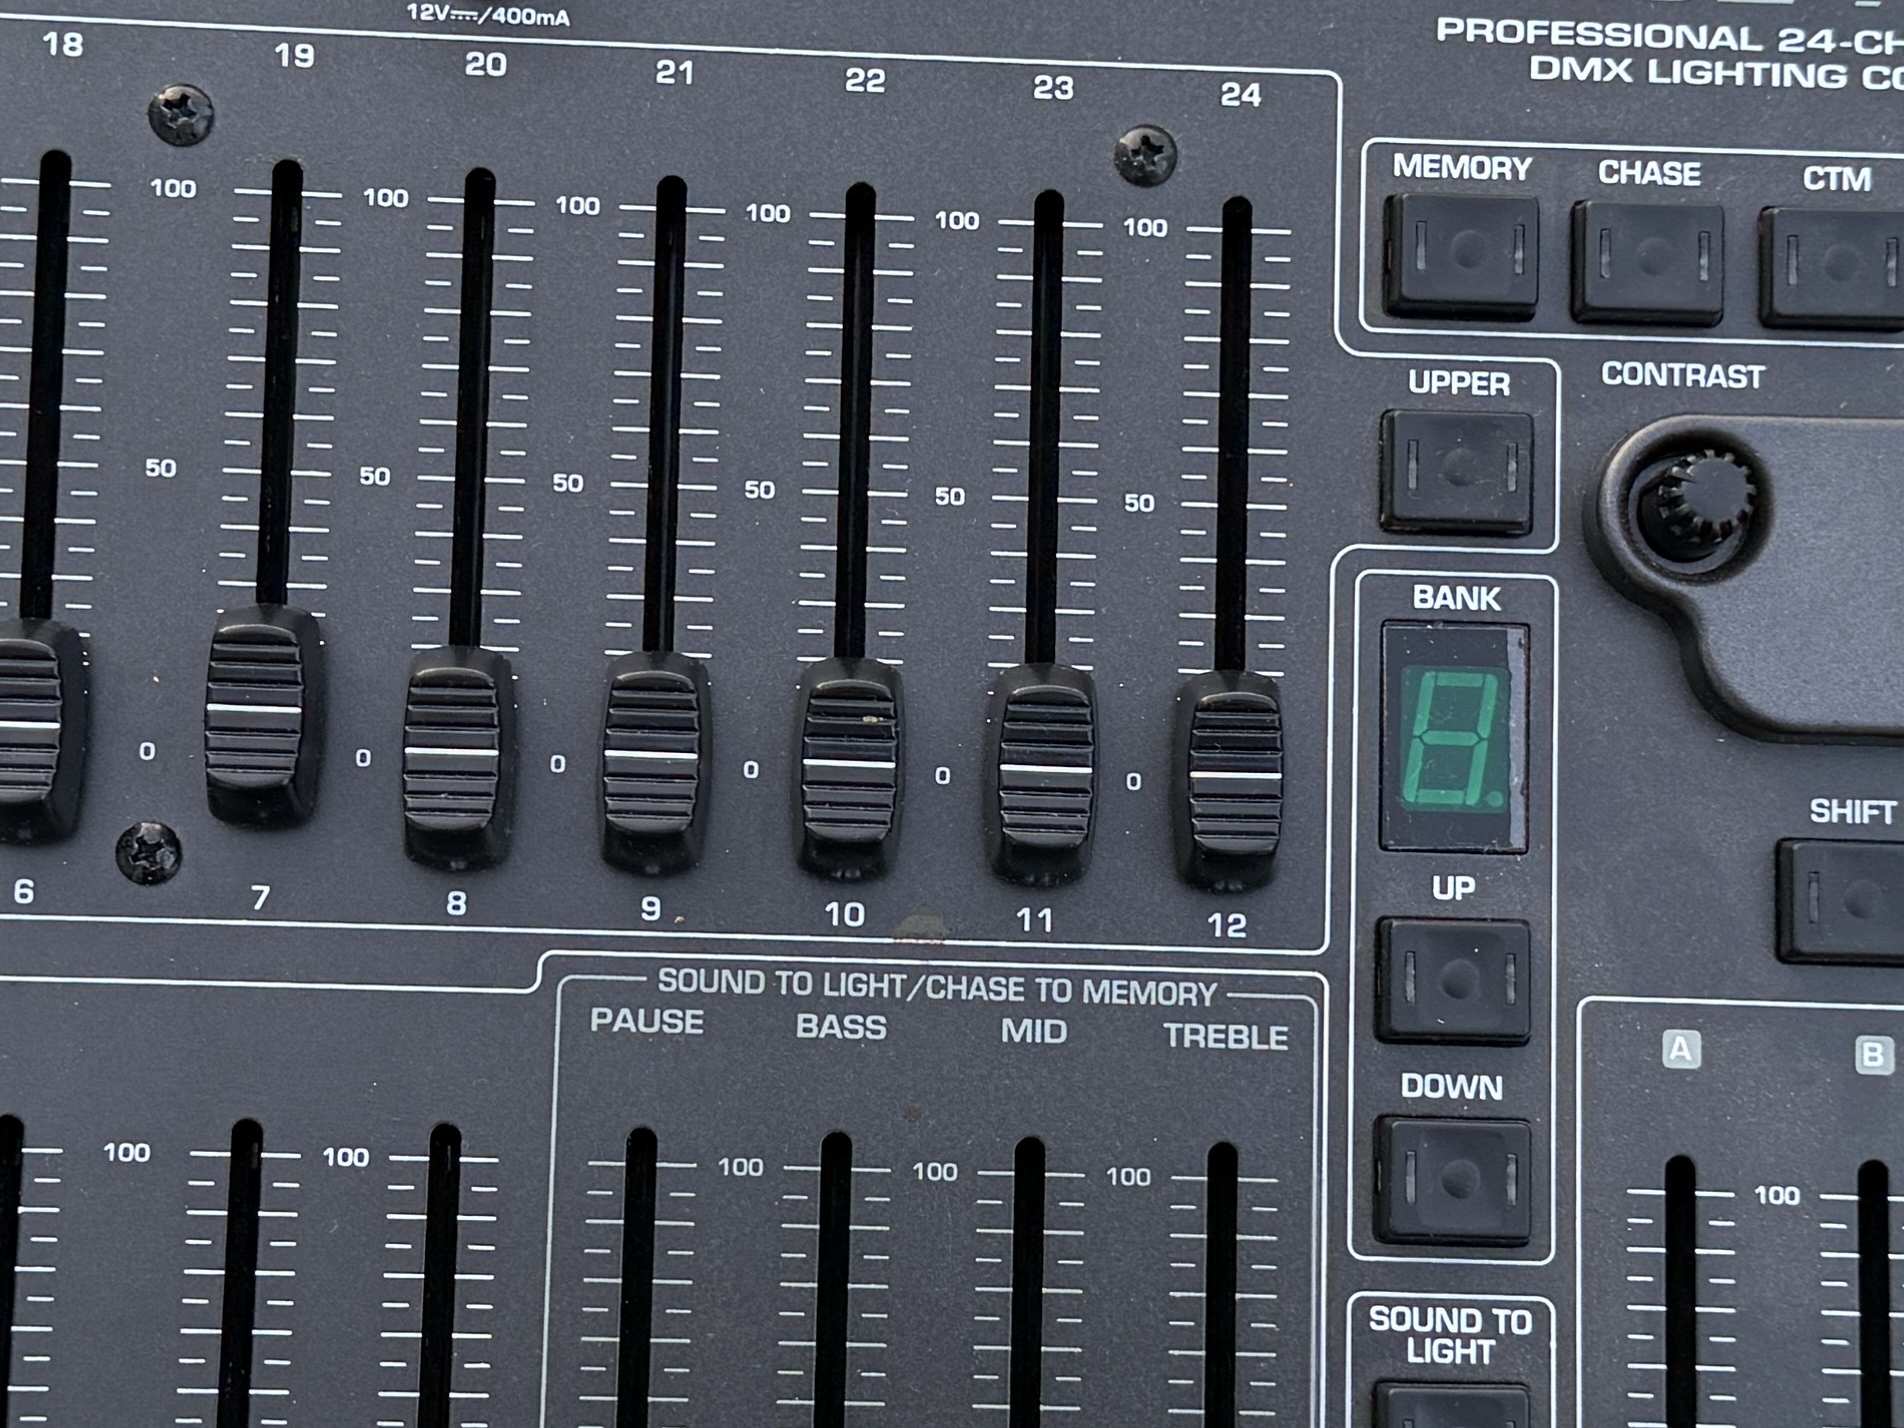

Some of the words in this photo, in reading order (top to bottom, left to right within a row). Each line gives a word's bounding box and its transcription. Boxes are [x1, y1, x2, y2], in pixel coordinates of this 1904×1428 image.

[43, 31, 83, 57] 18
[1438, 17, 1764, 52] PROFESSIONAL
[275, 42, 315, 68] 19
[465, 51, 507, 77] 20
[656, 59, 693, 85] 21
[845, 67, 886, 93] 22
[1531, 55, 1634, 83] DMX
[1648, 58, 1847, 91] LIGHTING
[1033, 74, 1074, 100] 23
[1221, 81, 1262, 107] 24
[1394, 152, 1533, 181] MEMORY
[1599, 159, 1701, 186] CHASE
[1804, 165, 1872, 192] CTM
[1409, 369, 1511, 396] UPPER
[1602, 360, 1767, 389] CONTRAST
[1413, 584, 1501, 611] BANK
[1810, 798, 1898, 825] SHIFT
[14, 878, 34, 904] 6
[251, 884, 270, 910] 7
[1433, 875, 1476, 901] UP
[446, 891, 466, 916] 8
[641, 896, 661, 921] 9
[825, 901, 865, 927] 10
[1016, 907, 1052, 933] 11
[1208, 912, 1247, 938] 12
[658, 966, 763, 996] SOUND
[774, 969, 815, 996] TO
[823, 972, 1025, 1002] LIGHT/CHASE
[1034, 976, 1073, 1006] TO
[1082, 979, 1218, 1007] MEMORY
[591, 1007, 704, 1034] PAUSE
[796, 1013, 887, 1040] BASS
[1002, 1018, 1067, 1044] MID
[1163, 1022, 1289, 1051] TREBLE
[1669, 1035, 1692, 1061] A
[1863, 1042, 1884, 1067] B
[1401, 1073, 1503, 1101] DOWN
[1754, 1185, 1801, 1206] 100
[1370, 1305, 1482, 1333] SOUND
[1492, 1308, 1533, 1335] TO
[1407, 1337, 1496, 1365] LIGHT
